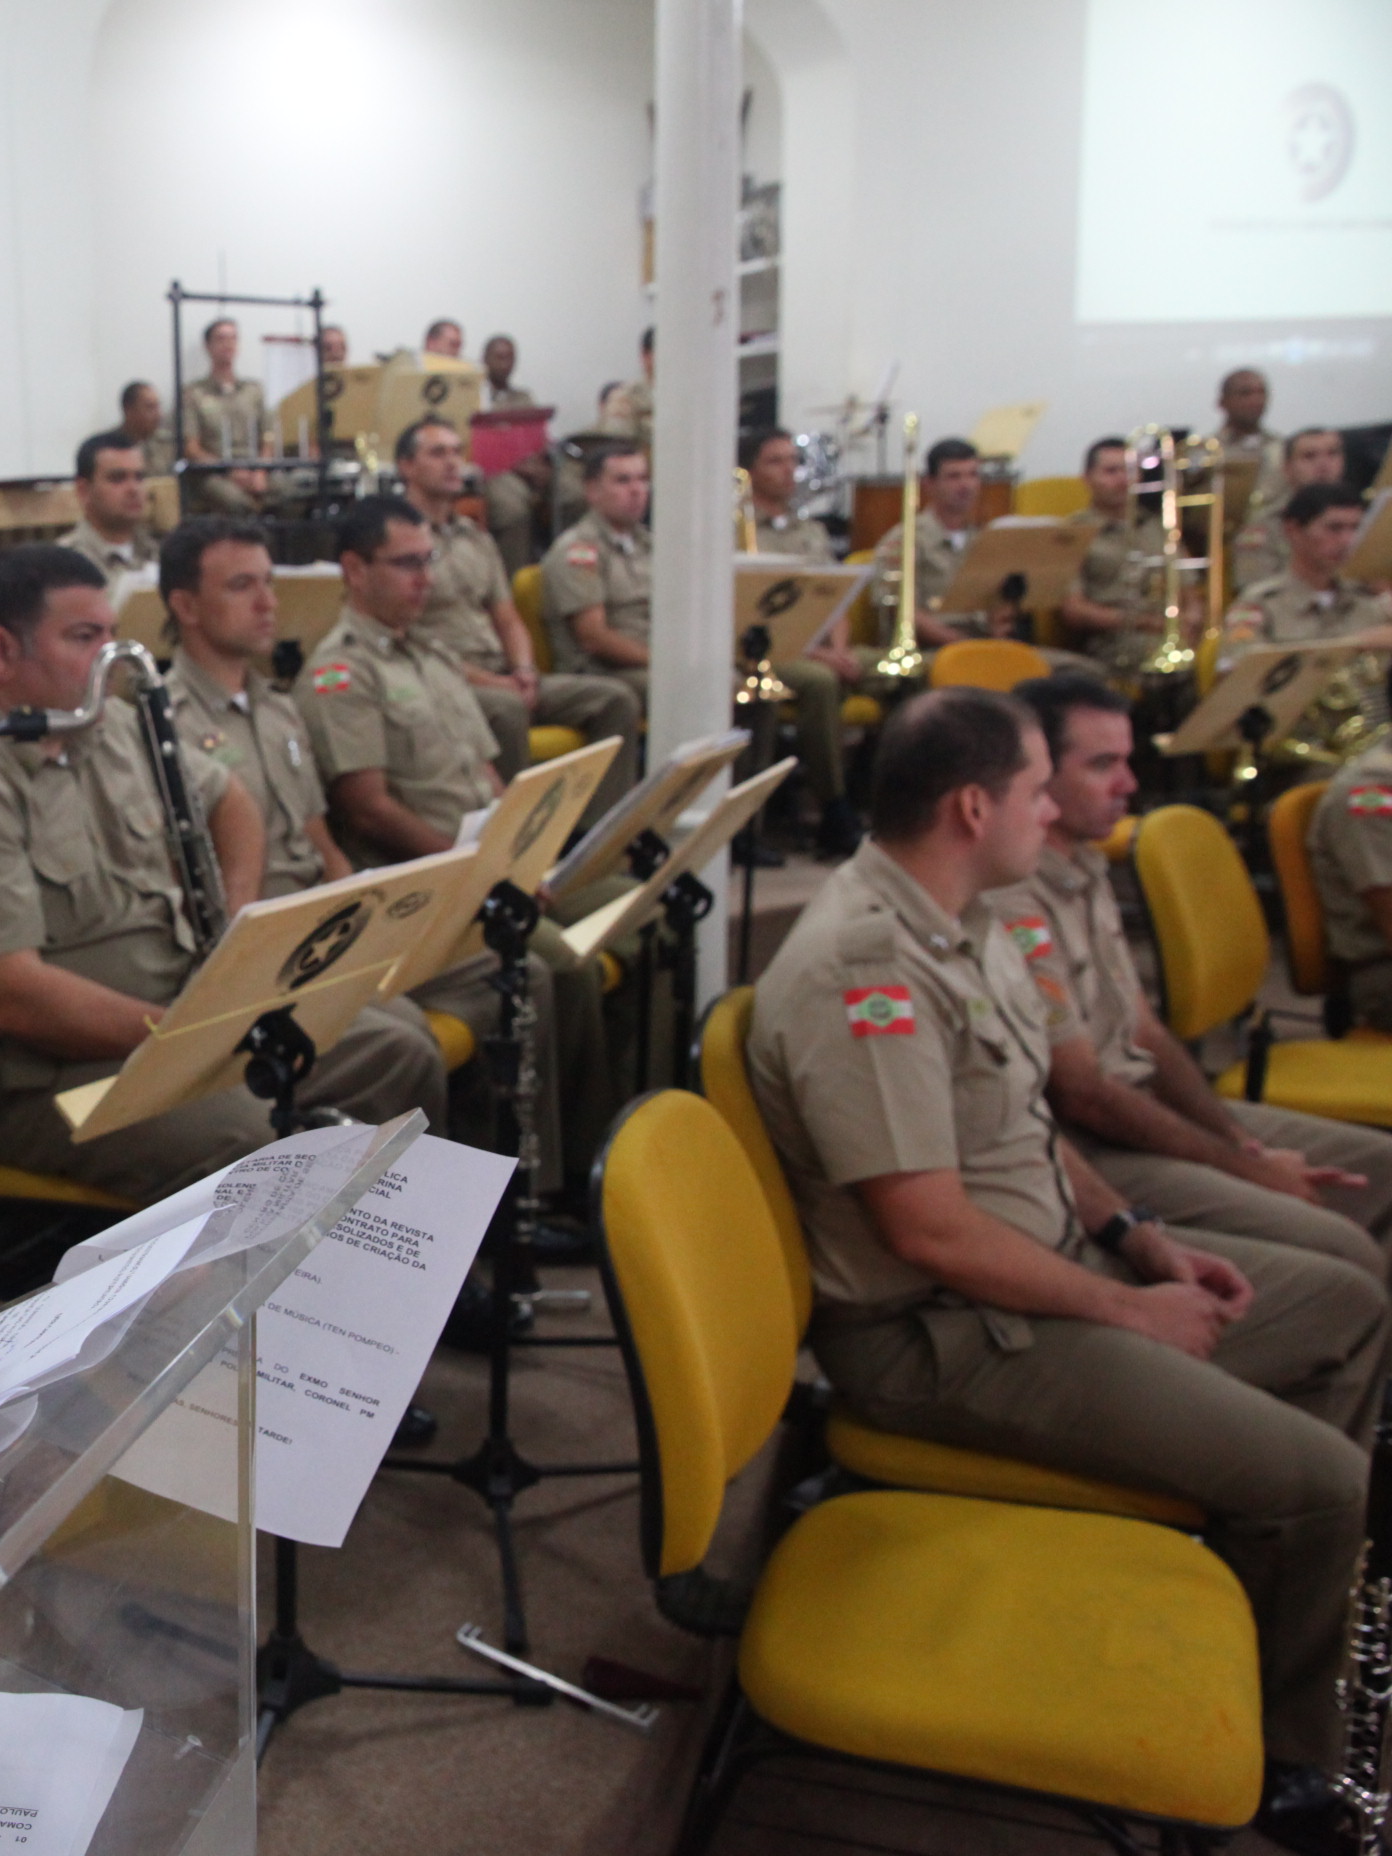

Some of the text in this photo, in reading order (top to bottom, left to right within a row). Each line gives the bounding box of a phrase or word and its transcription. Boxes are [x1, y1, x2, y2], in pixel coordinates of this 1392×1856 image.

[340, 1215, 420, 1248] ONTRATO PARA
[373, 1213, 388, 1226] DA
[390, 1221, 435, 1243] REVISTA
[346, 1236, 361, 1248] DE
[363, 1242, 410, 1265] CRIAÇÃO
[412, 1260, 427, 1271] DA
[396, 1243, 404, 1253] E
[406, 1247, 421, 1259] DE
[267, 1301, 282, 1313] DE
[322, 1322, 346, 1337] (TEN
[348, 1331, 395, 1355] POMPEO)
[273, 1362, 290, 1374] DO
[299, 1372, 328, 1388] EXMO
[338, 1387, 381, 1406] SENHOR
[304, 1389, 351, 1411] CORONEL
[360, 1408, 375, 1419] PM
[257, 1426, 293, 1445] TARDE!
[0, 1805, 39, 1819] PAULO
